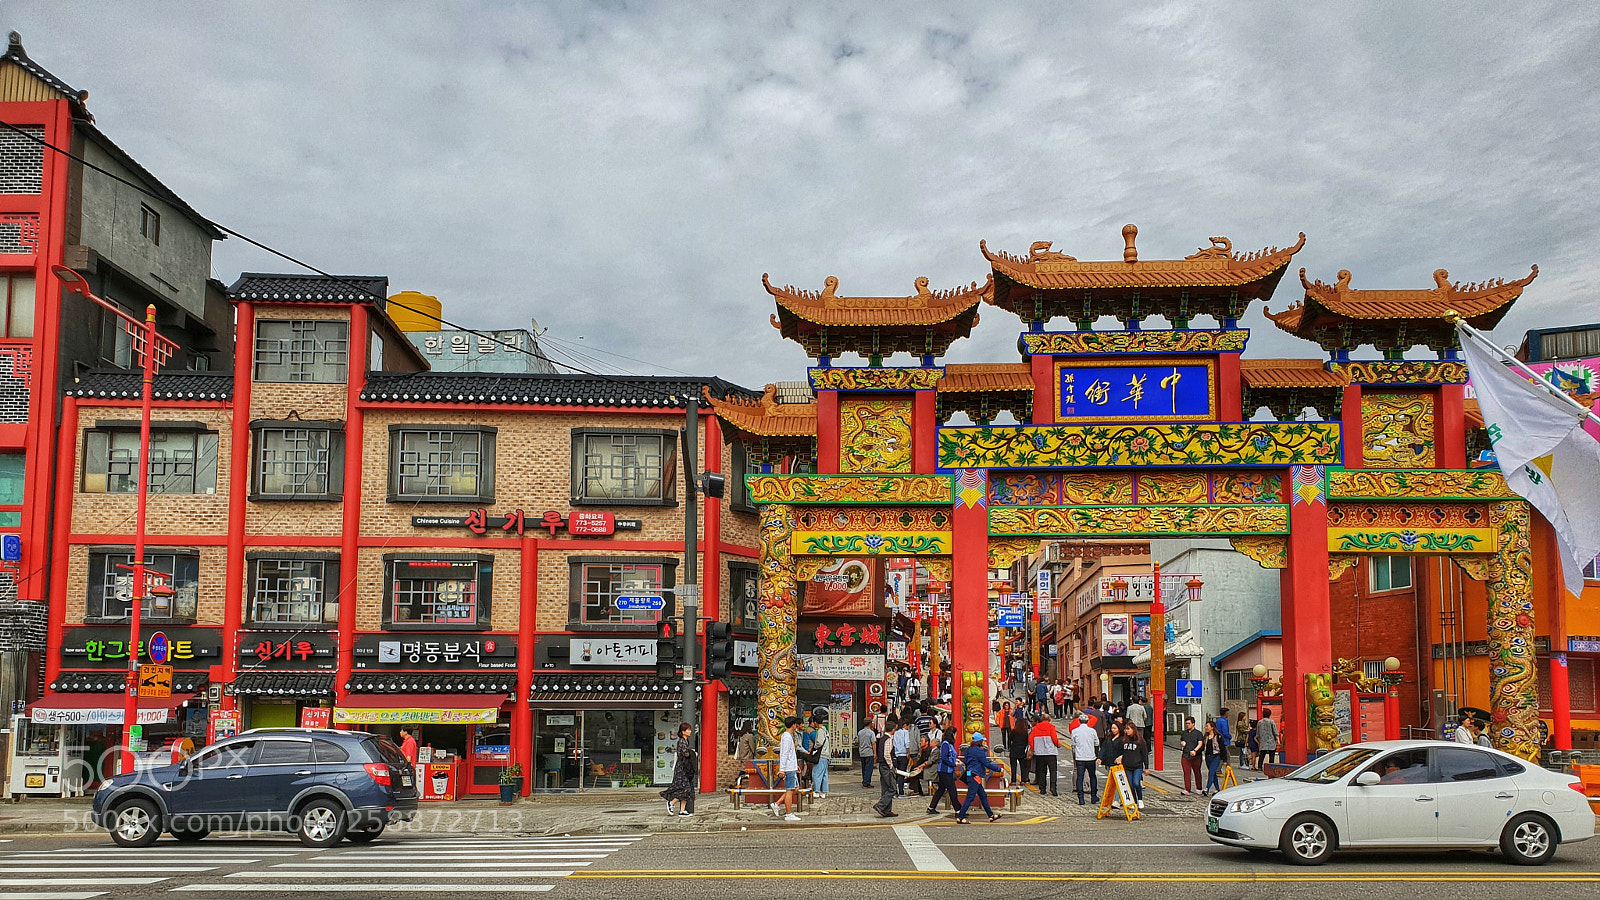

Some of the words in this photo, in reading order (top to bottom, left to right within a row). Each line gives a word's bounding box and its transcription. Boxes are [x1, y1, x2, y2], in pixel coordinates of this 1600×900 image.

[416, 517, 439, 525] Chinese
[463, 508, 566, 536] 신기루
[998, 611, 1006, 620] P
[255, 640, 314, 661] 신기루
[402, 641, 481, 663] 명동분식
